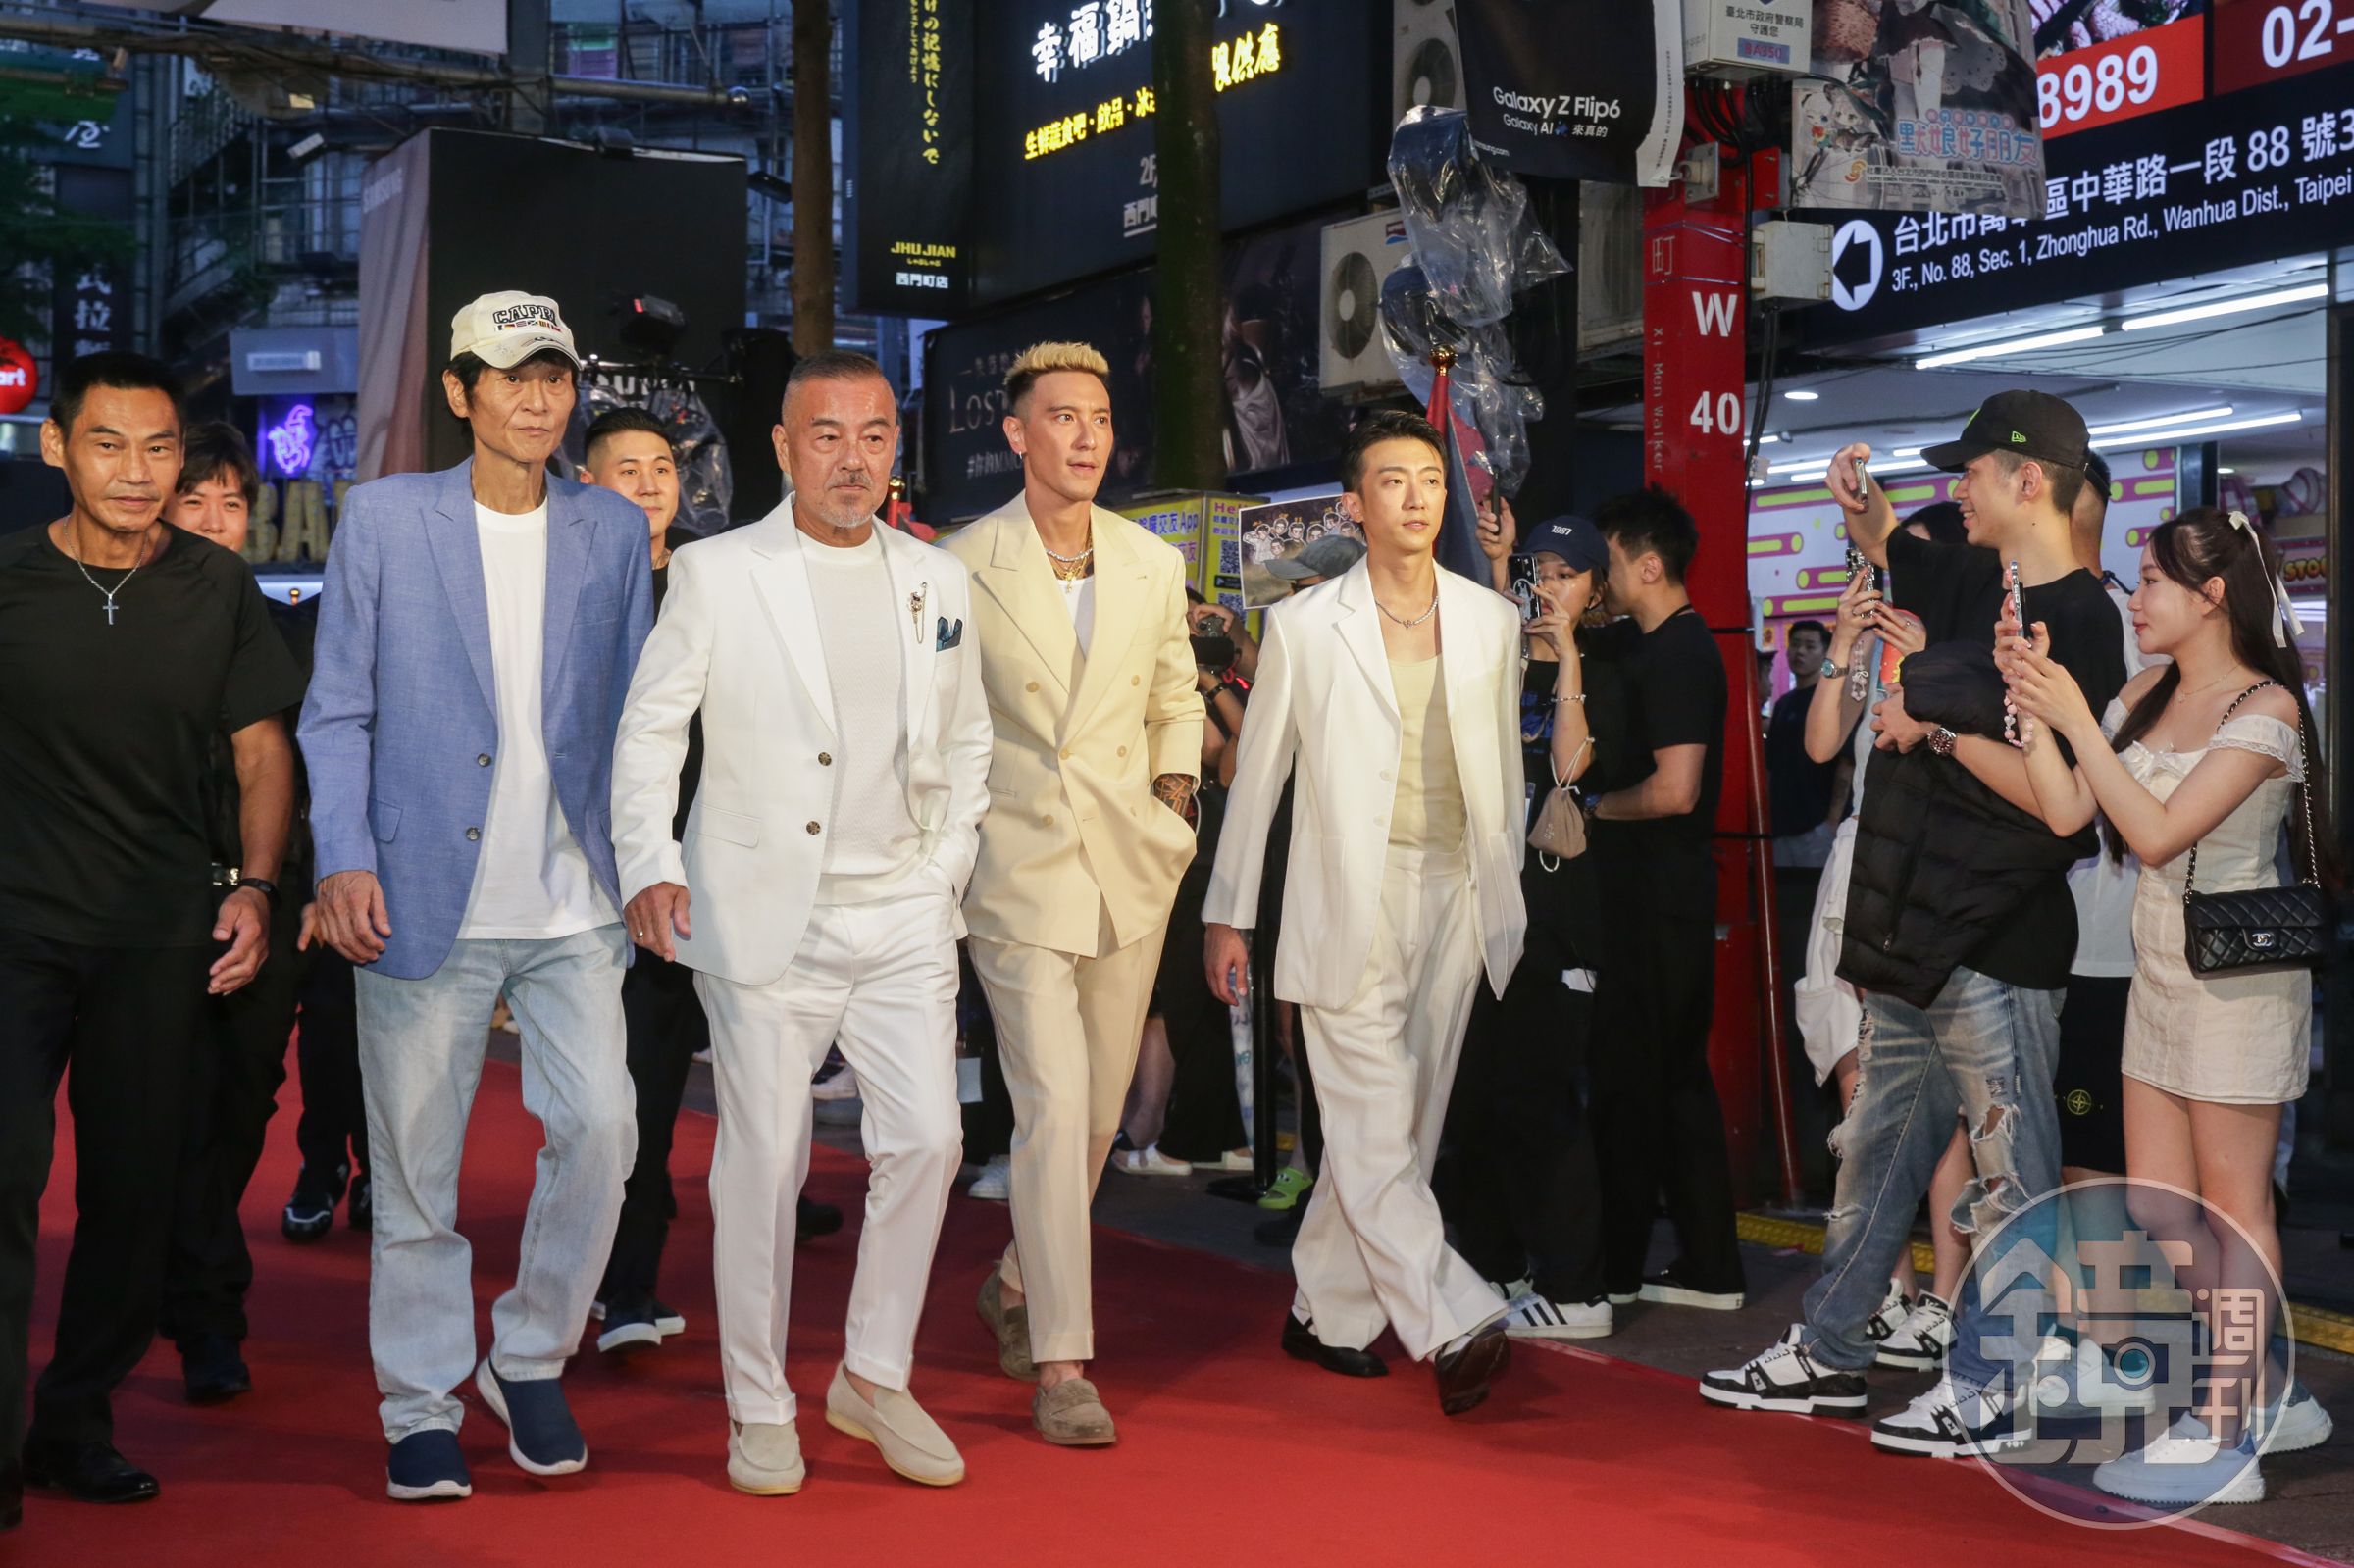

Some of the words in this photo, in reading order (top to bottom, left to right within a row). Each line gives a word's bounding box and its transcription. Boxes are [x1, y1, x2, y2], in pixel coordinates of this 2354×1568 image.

[1726, 5, 1804, 28] 臺北市政府警察局
[1750, 23, 1779, 37] 守護您
[1032, 0, 1153, 82] 幸福鍋
[1493, 86, 1555, 119] Galaxy
[1558, 95, 1570, 115] Z
[1573, 95, 1621, 124] Flip6
[1503, 113, 1539, 136] Galaxy
[1540, 122, 1554, 135] AI
[1572, 124, 1609, 138] 來真的
[2246, 125, 2291, 173] 88
[1921, 262, 1947, 286] No.
[1951, 252, 1975, 278] 88,
[1978, 248, 2013, 274] Sec.
[2036, 224, 2119, 260] Zhonghua
[2124, 213, 2159, 242] Rd.,
[2163, 199, 2237, 232] Wanhua
[2242, 184, 2289, 216] Dist.,
[2294, 167, 2352, 205] Taipei
[896, 272, 949, 289] 西門町店
[1691, 291, 1737, 337] W
[1690, 390, 1741, 435] 40
